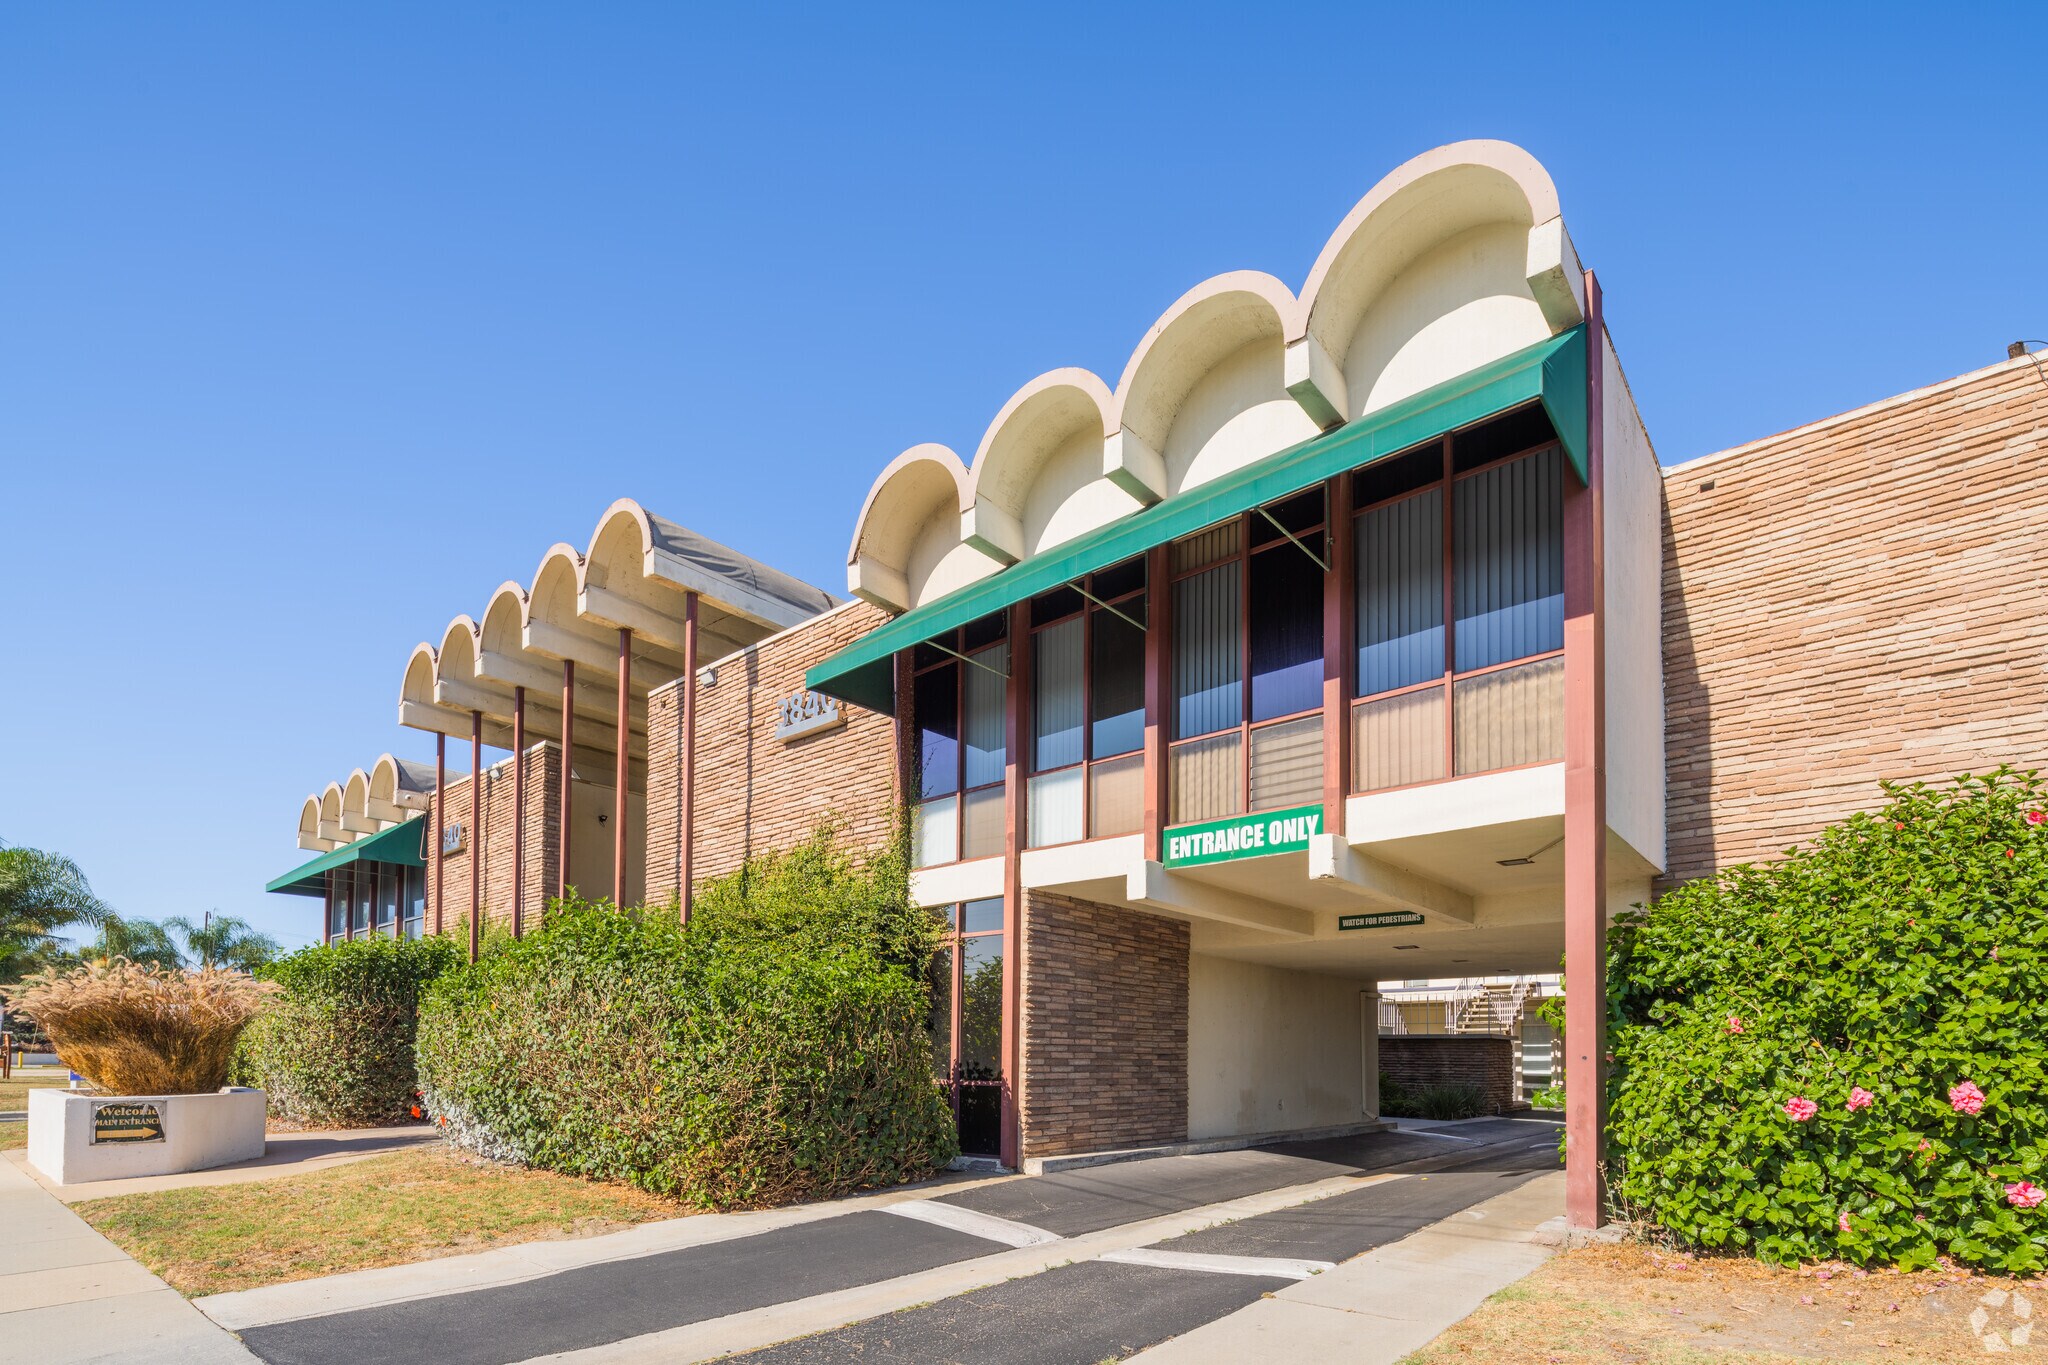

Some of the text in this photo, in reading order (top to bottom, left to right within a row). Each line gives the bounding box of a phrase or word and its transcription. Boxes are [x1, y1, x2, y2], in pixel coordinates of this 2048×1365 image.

[1170, 814, 1319, 859] ENTRANCE ONLY
[1342, 913, 1421, 927] WATCH FOR PEDESTRIANS
